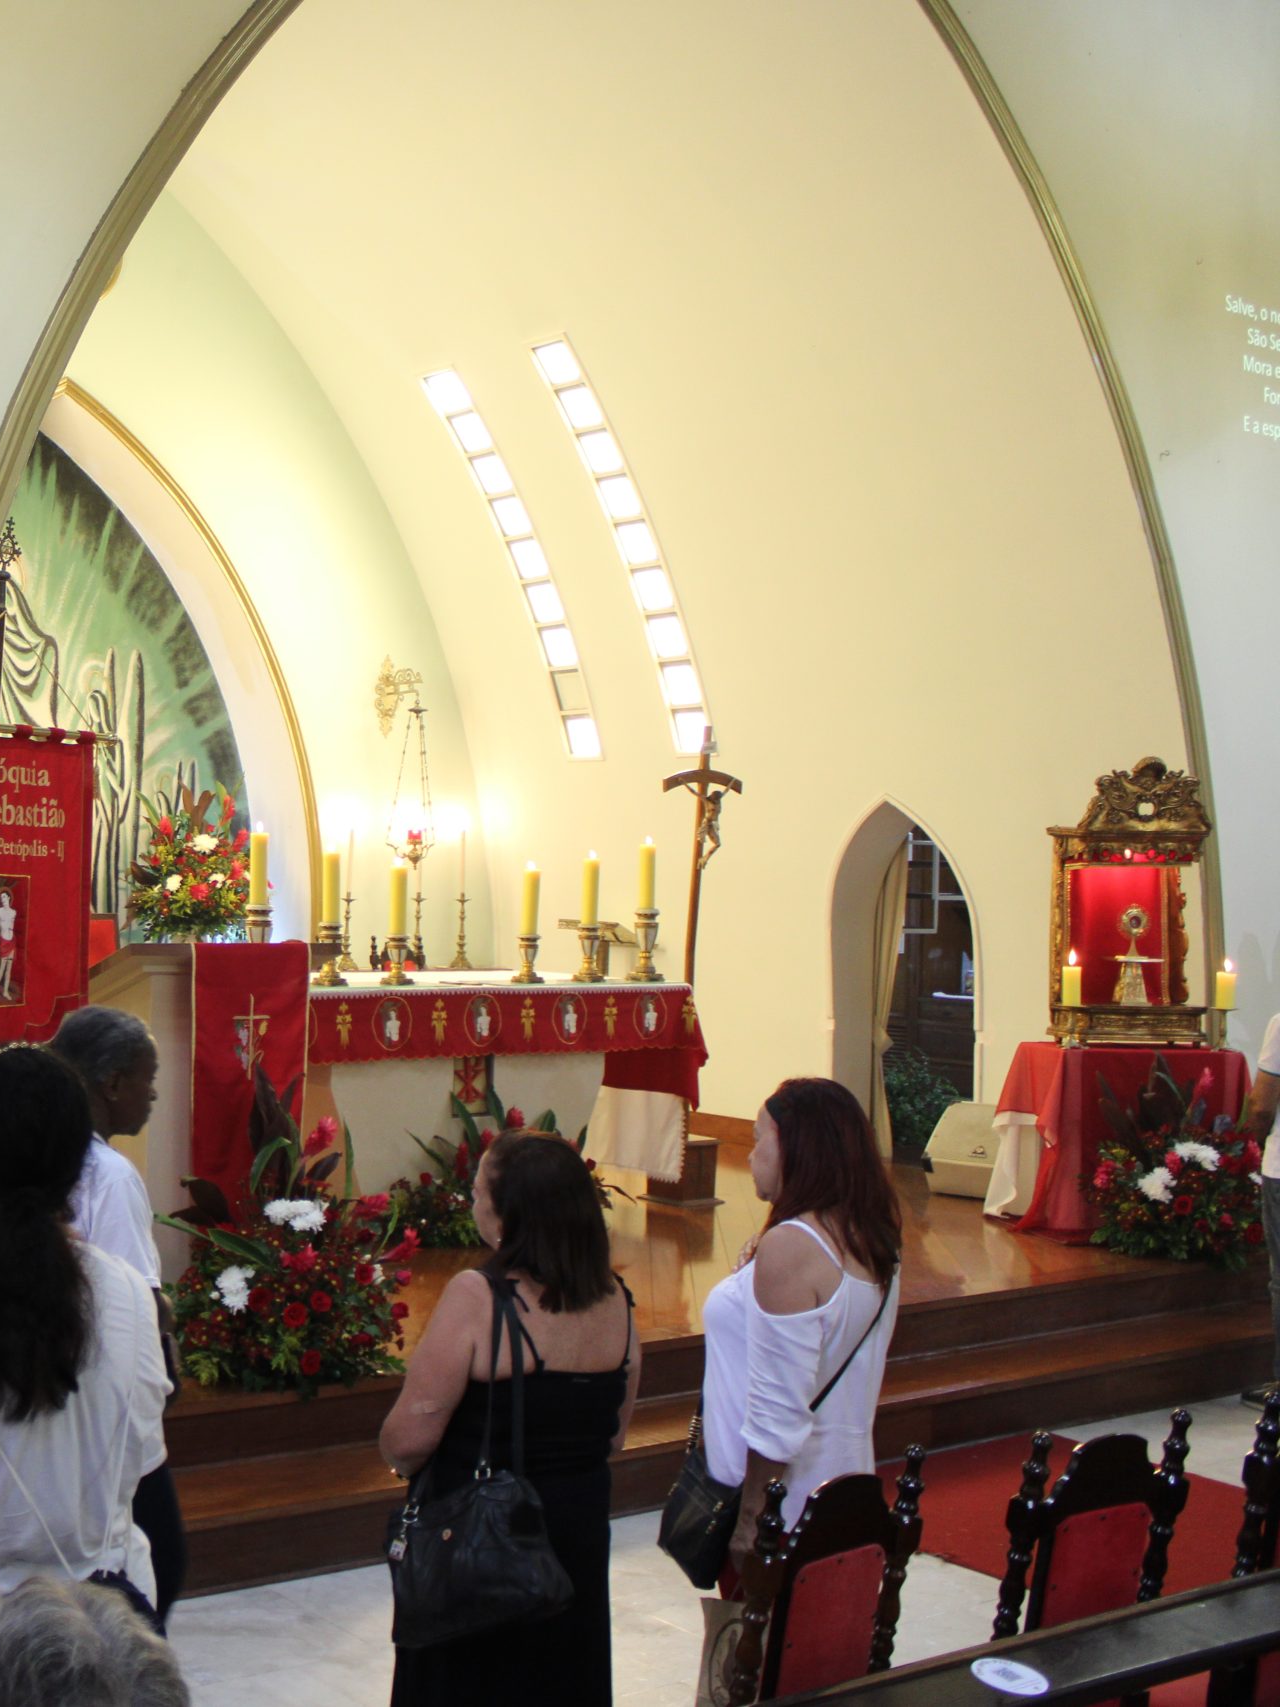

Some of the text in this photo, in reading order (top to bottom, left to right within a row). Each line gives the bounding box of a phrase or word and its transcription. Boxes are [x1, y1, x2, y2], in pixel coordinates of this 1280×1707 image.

[1225, 295, 1257, 321] Salve,
[1260, 308, 1268, 321] o
[1247, 328, 1268, 348] São
[1243, 355, 1272, 376] Mora
[1243, 416, 1250, 432] E
[1253, 421, 1260, 434] a
